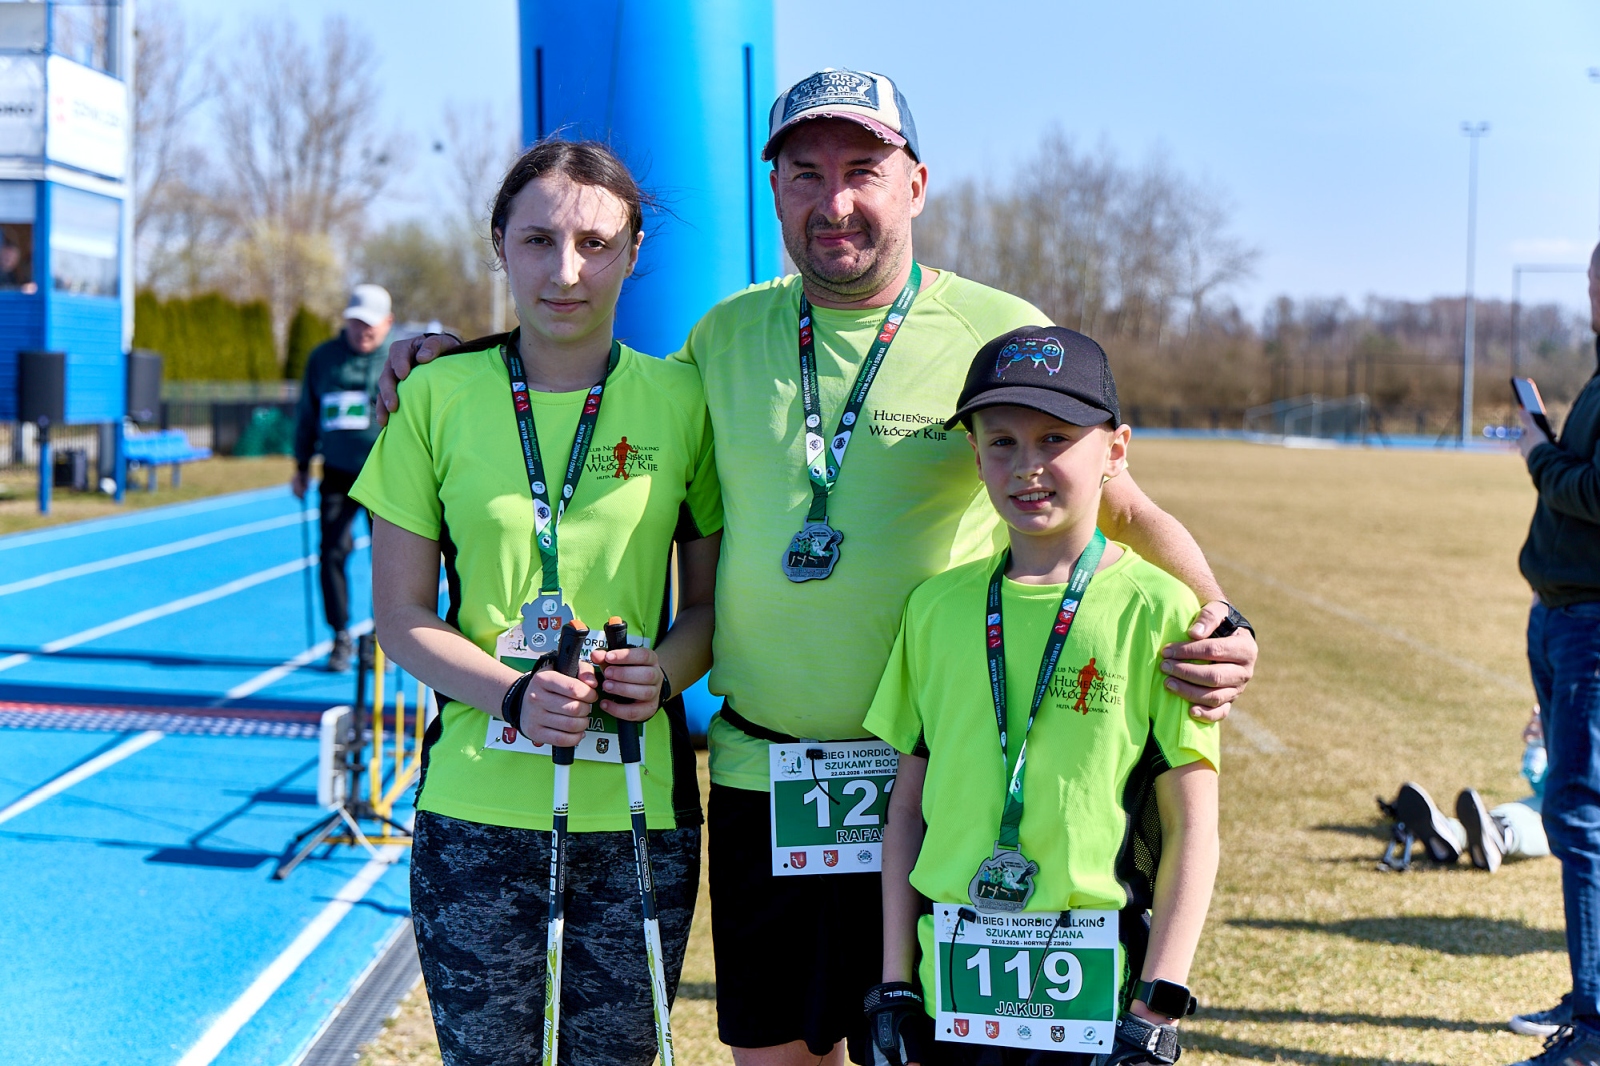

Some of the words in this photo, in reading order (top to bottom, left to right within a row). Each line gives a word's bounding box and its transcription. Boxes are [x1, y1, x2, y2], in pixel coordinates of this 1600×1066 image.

[801, 73, 860, 91] MOTORS
[804, 79, 856, 92] RACING
[809, 86, 850, 96] TEAM
[924, 428, 947, 441] KIJE
[638, 460, 658, 472] KIJE
[1100, 692, 1121, 705] KIJE
[822, 751, 844, 760] BIEG
[852, 748, 891, 758] NORDIC
[824, 760, 872, 770] SZUKAMY
[875, 758, 899, 768] BOCI
[836, 828, 885, 844] RAFA
[982, 916, 1004, 926] BIEG
[1012, 918, 1052, 927] NORDIC
[1055, 917, 1104, 928] LKING
[986, 928, 1033, 938] SZUKAMY
[1036, 930, 1084, 939] BOCIANA
[966, 948, 1083, 1002] 119
[995, 1001, 1055, 1018] JAKUB
